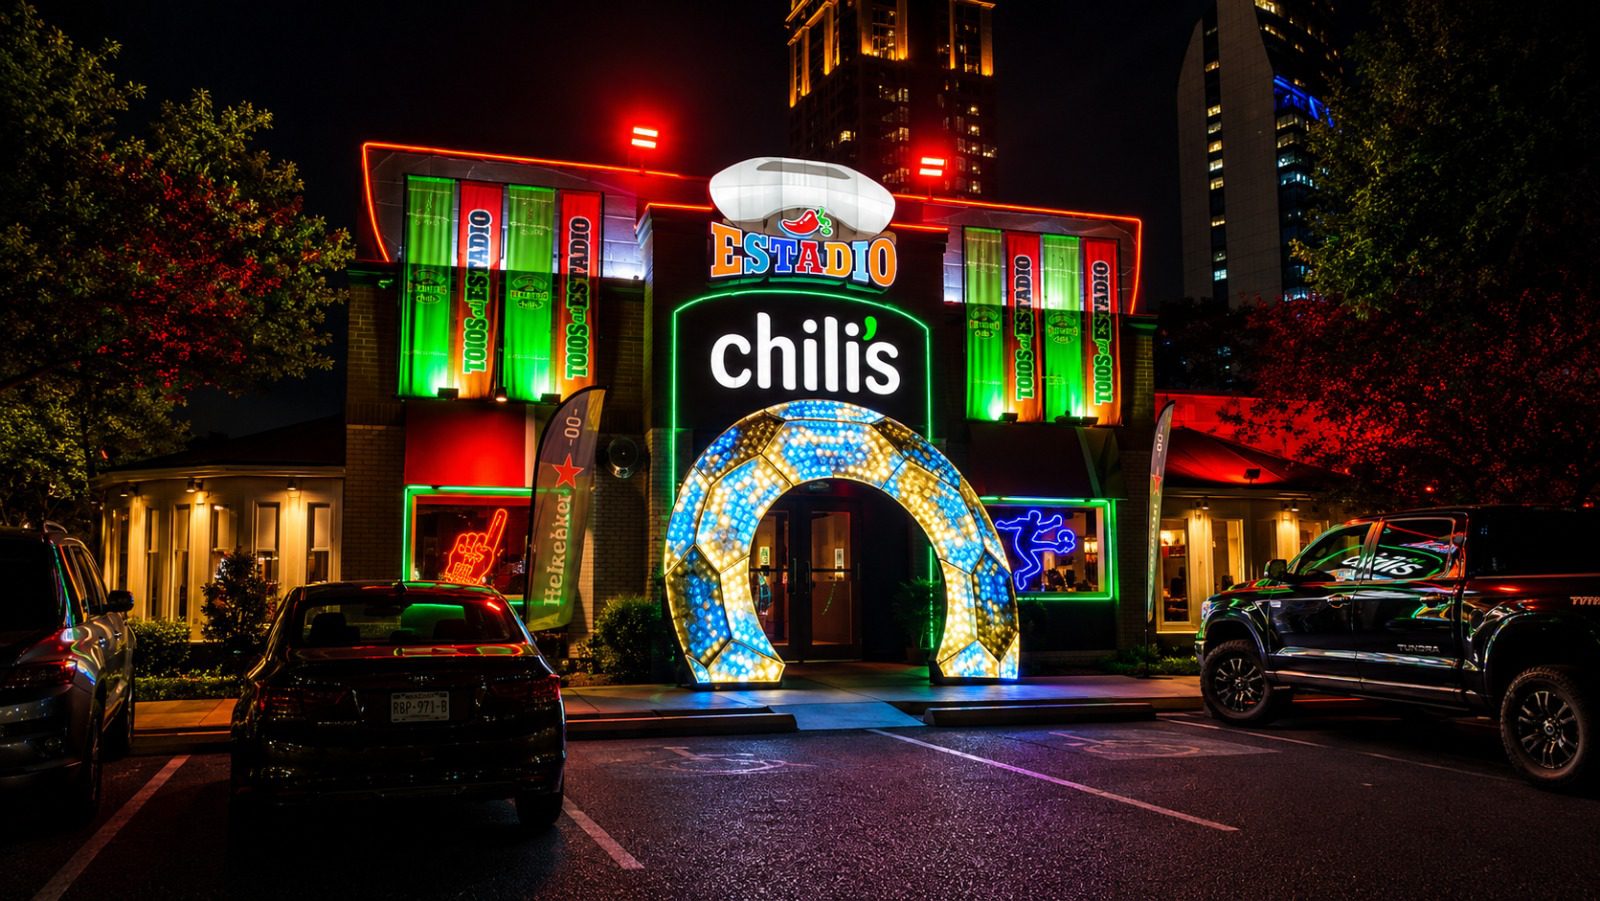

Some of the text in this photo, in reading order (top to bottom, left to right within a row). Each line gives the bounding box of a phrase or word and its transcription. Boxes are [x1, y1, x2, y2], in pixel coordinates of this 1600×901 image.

[464, 208, 492, 302] ESTADIO
[566, 216, 592, 309] ESTADIO
[710, 221, 897, 287] ESTADIO
[1014, 254, 1034, 337] ESTADIO
[1092, 260, 1111, 343] ESTADIO
[710, 312, 900, 395] chili's
[1396, 643, 1441, 654] TUNDRA
